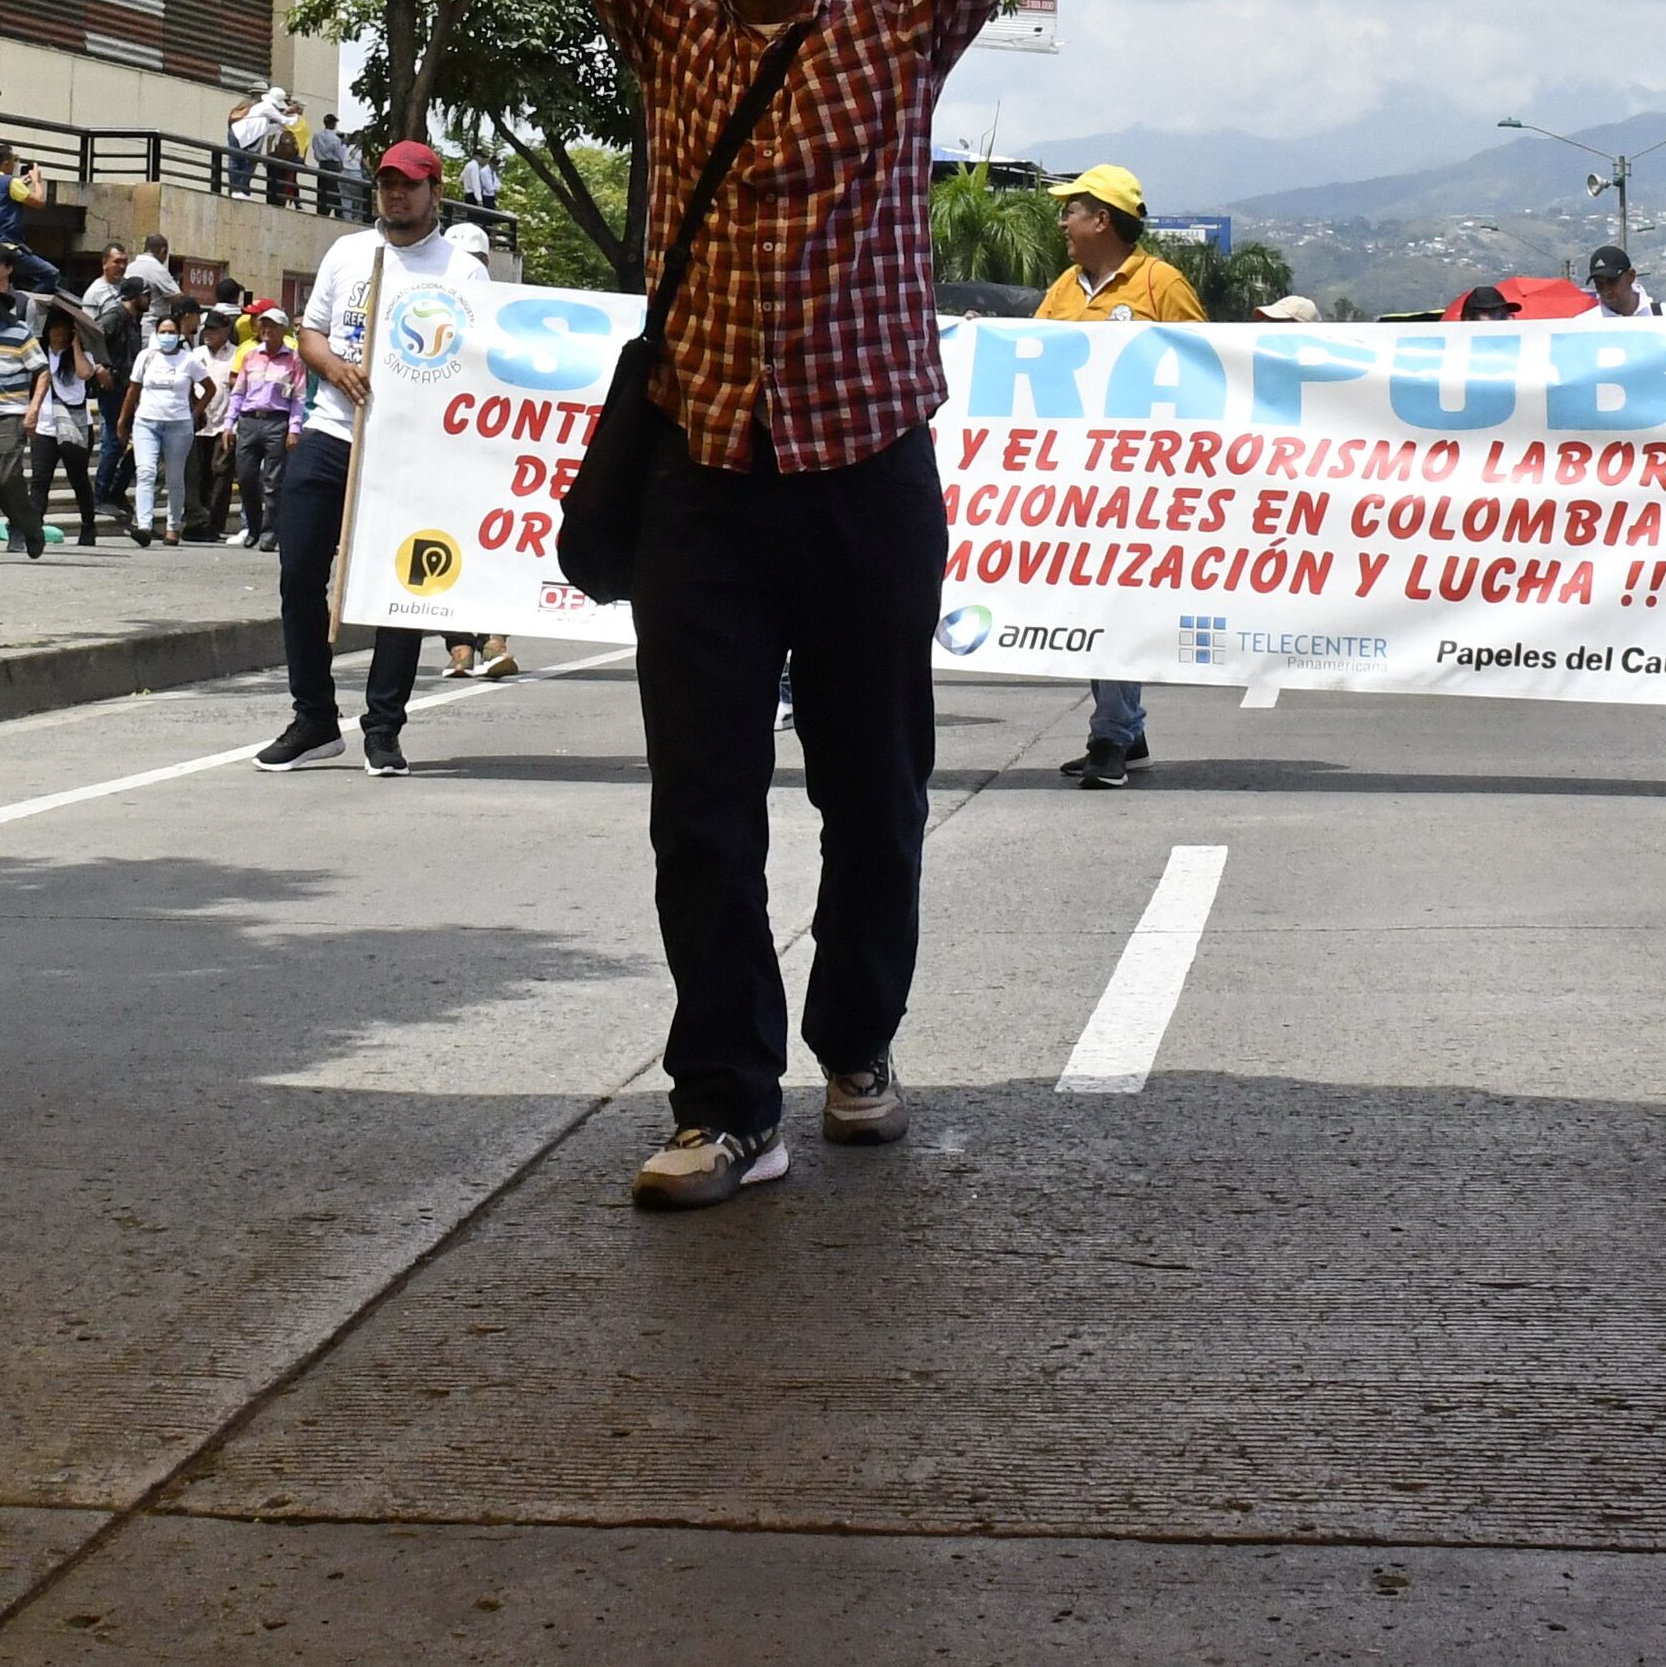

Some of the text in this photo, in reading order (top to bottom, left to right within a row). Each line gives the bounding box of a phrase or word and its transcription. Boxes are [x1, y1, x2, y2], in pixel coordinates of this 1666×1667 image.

[343, 310, 367, 327] REF
[383, 352, 462, 384] SINTRAPUB
[957, 428, 990, 471] Y
[1002, 428, 1059, 472] EL
[1084, 428, 1461, 483] TERRORISMO
[942, 484, 1662, 547] ACIONALES EN COLOMBIA
[1355, 552, 1390, 598] Y
[1403, 553, 1594, 605] LUCHA
[998, 624, 1105, 653] amcor
[1236, 631, 1388, 659] TELECENTER
[1286, 655, 1389, 673] Panamericana
[1437, 639, 1557, 672] Papeles
[1565, 646, 1613, 672] del
